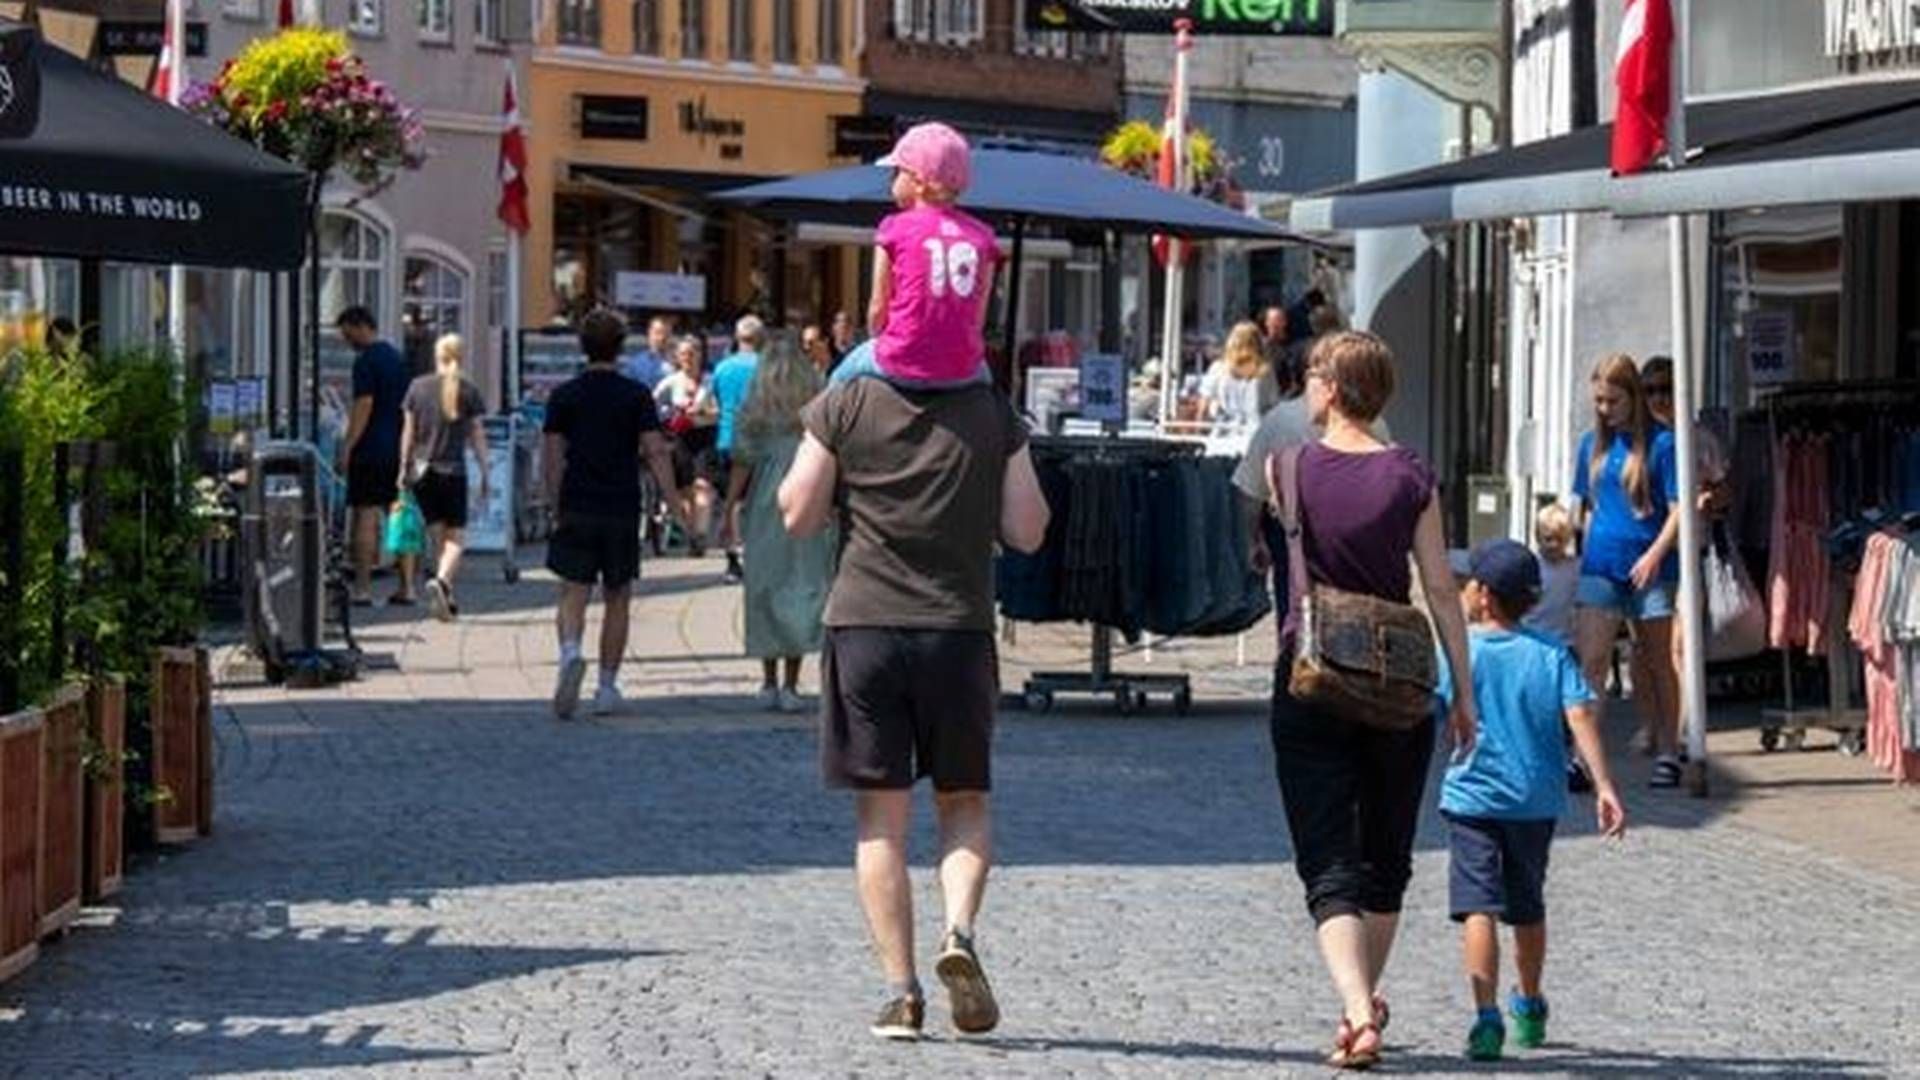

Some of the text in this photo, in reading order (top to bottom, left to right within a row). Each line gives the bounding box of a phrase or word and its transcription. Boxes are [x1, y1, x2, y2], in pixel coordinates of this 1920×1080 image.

[1259, 137, 1284, 176] 30
[2, 186, 201, 220] BEER IN THE WORLD
[922, 237, 979, 298] 10
